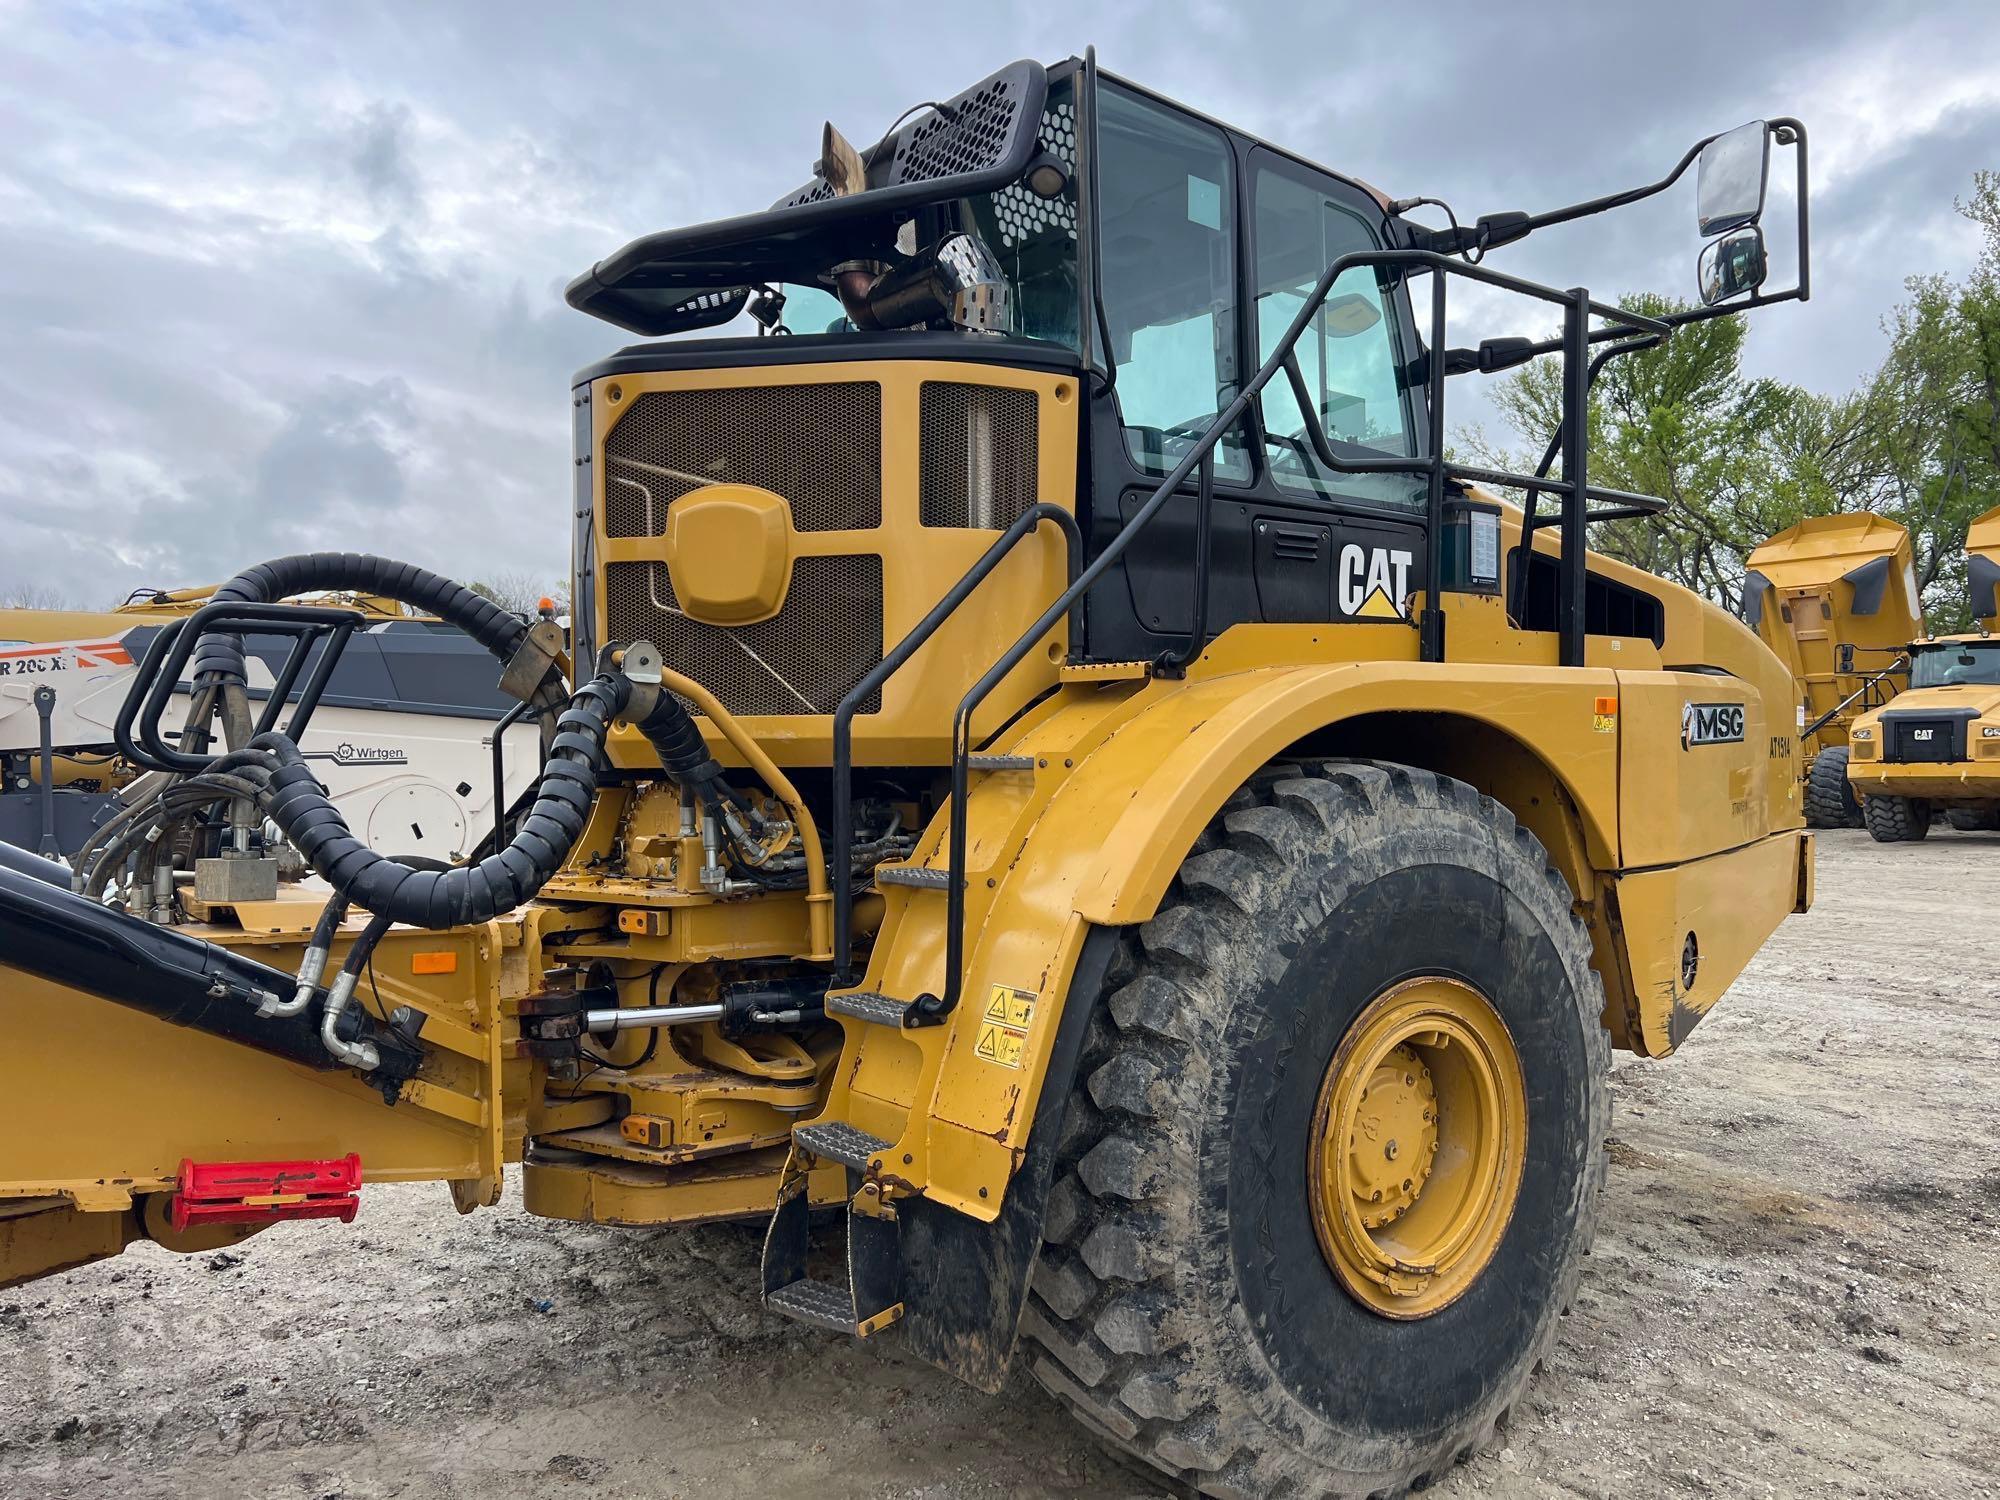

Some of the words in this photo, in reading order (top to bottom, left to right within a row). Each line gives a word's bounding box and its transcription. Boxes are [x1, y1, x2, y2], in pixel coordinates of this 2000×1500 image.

[1339, 543, 1412, 619] CAT
[1696, 708, 1744, 739] MSG
[1914, 729, 1934, 740] CAT
[356, 747, 403, 760] Wirtgen
[1769, 736, 1791, 759] AT1514
